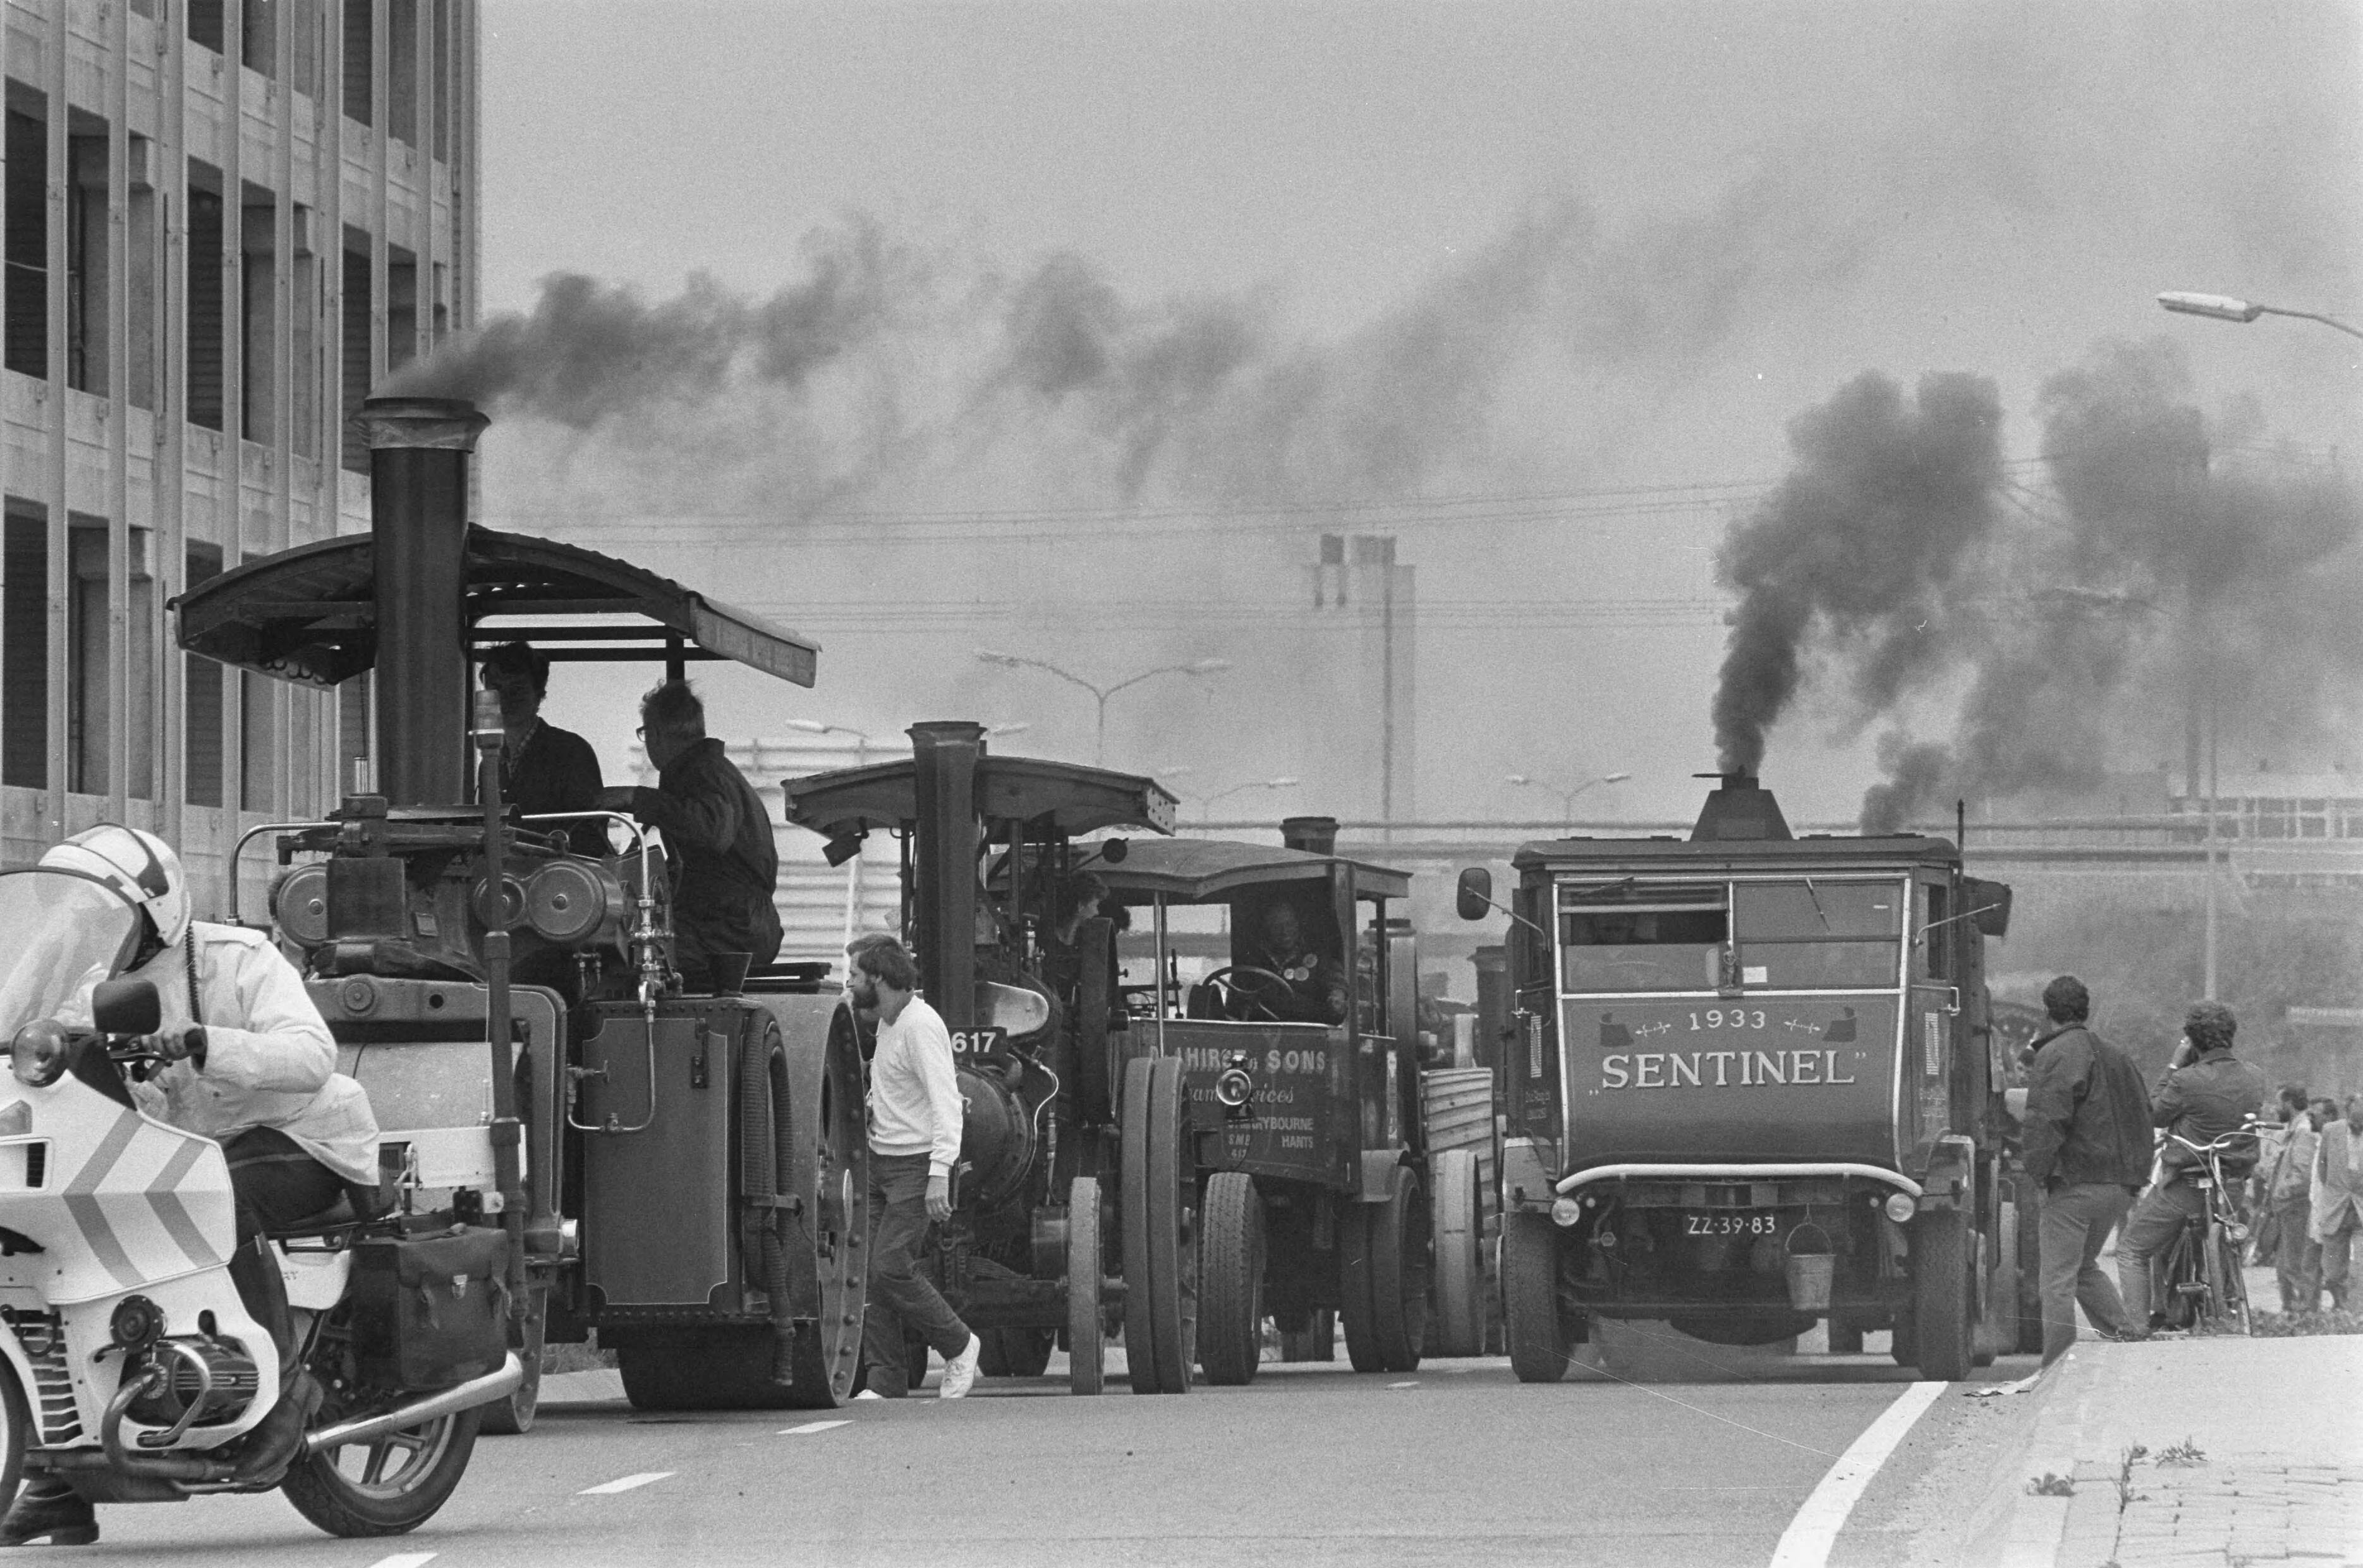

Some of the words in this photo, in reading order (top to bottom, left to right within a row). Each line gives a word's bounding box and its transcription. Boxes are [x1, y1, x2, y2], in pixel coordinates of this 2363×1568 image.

[1689, 1009, 1765, 1031] 1933
[951, 1031, 997, 1053] 617
[1266, 1049, 1326, 1073] SONS
[1282, 1136, 1314, 1149] HANTS
